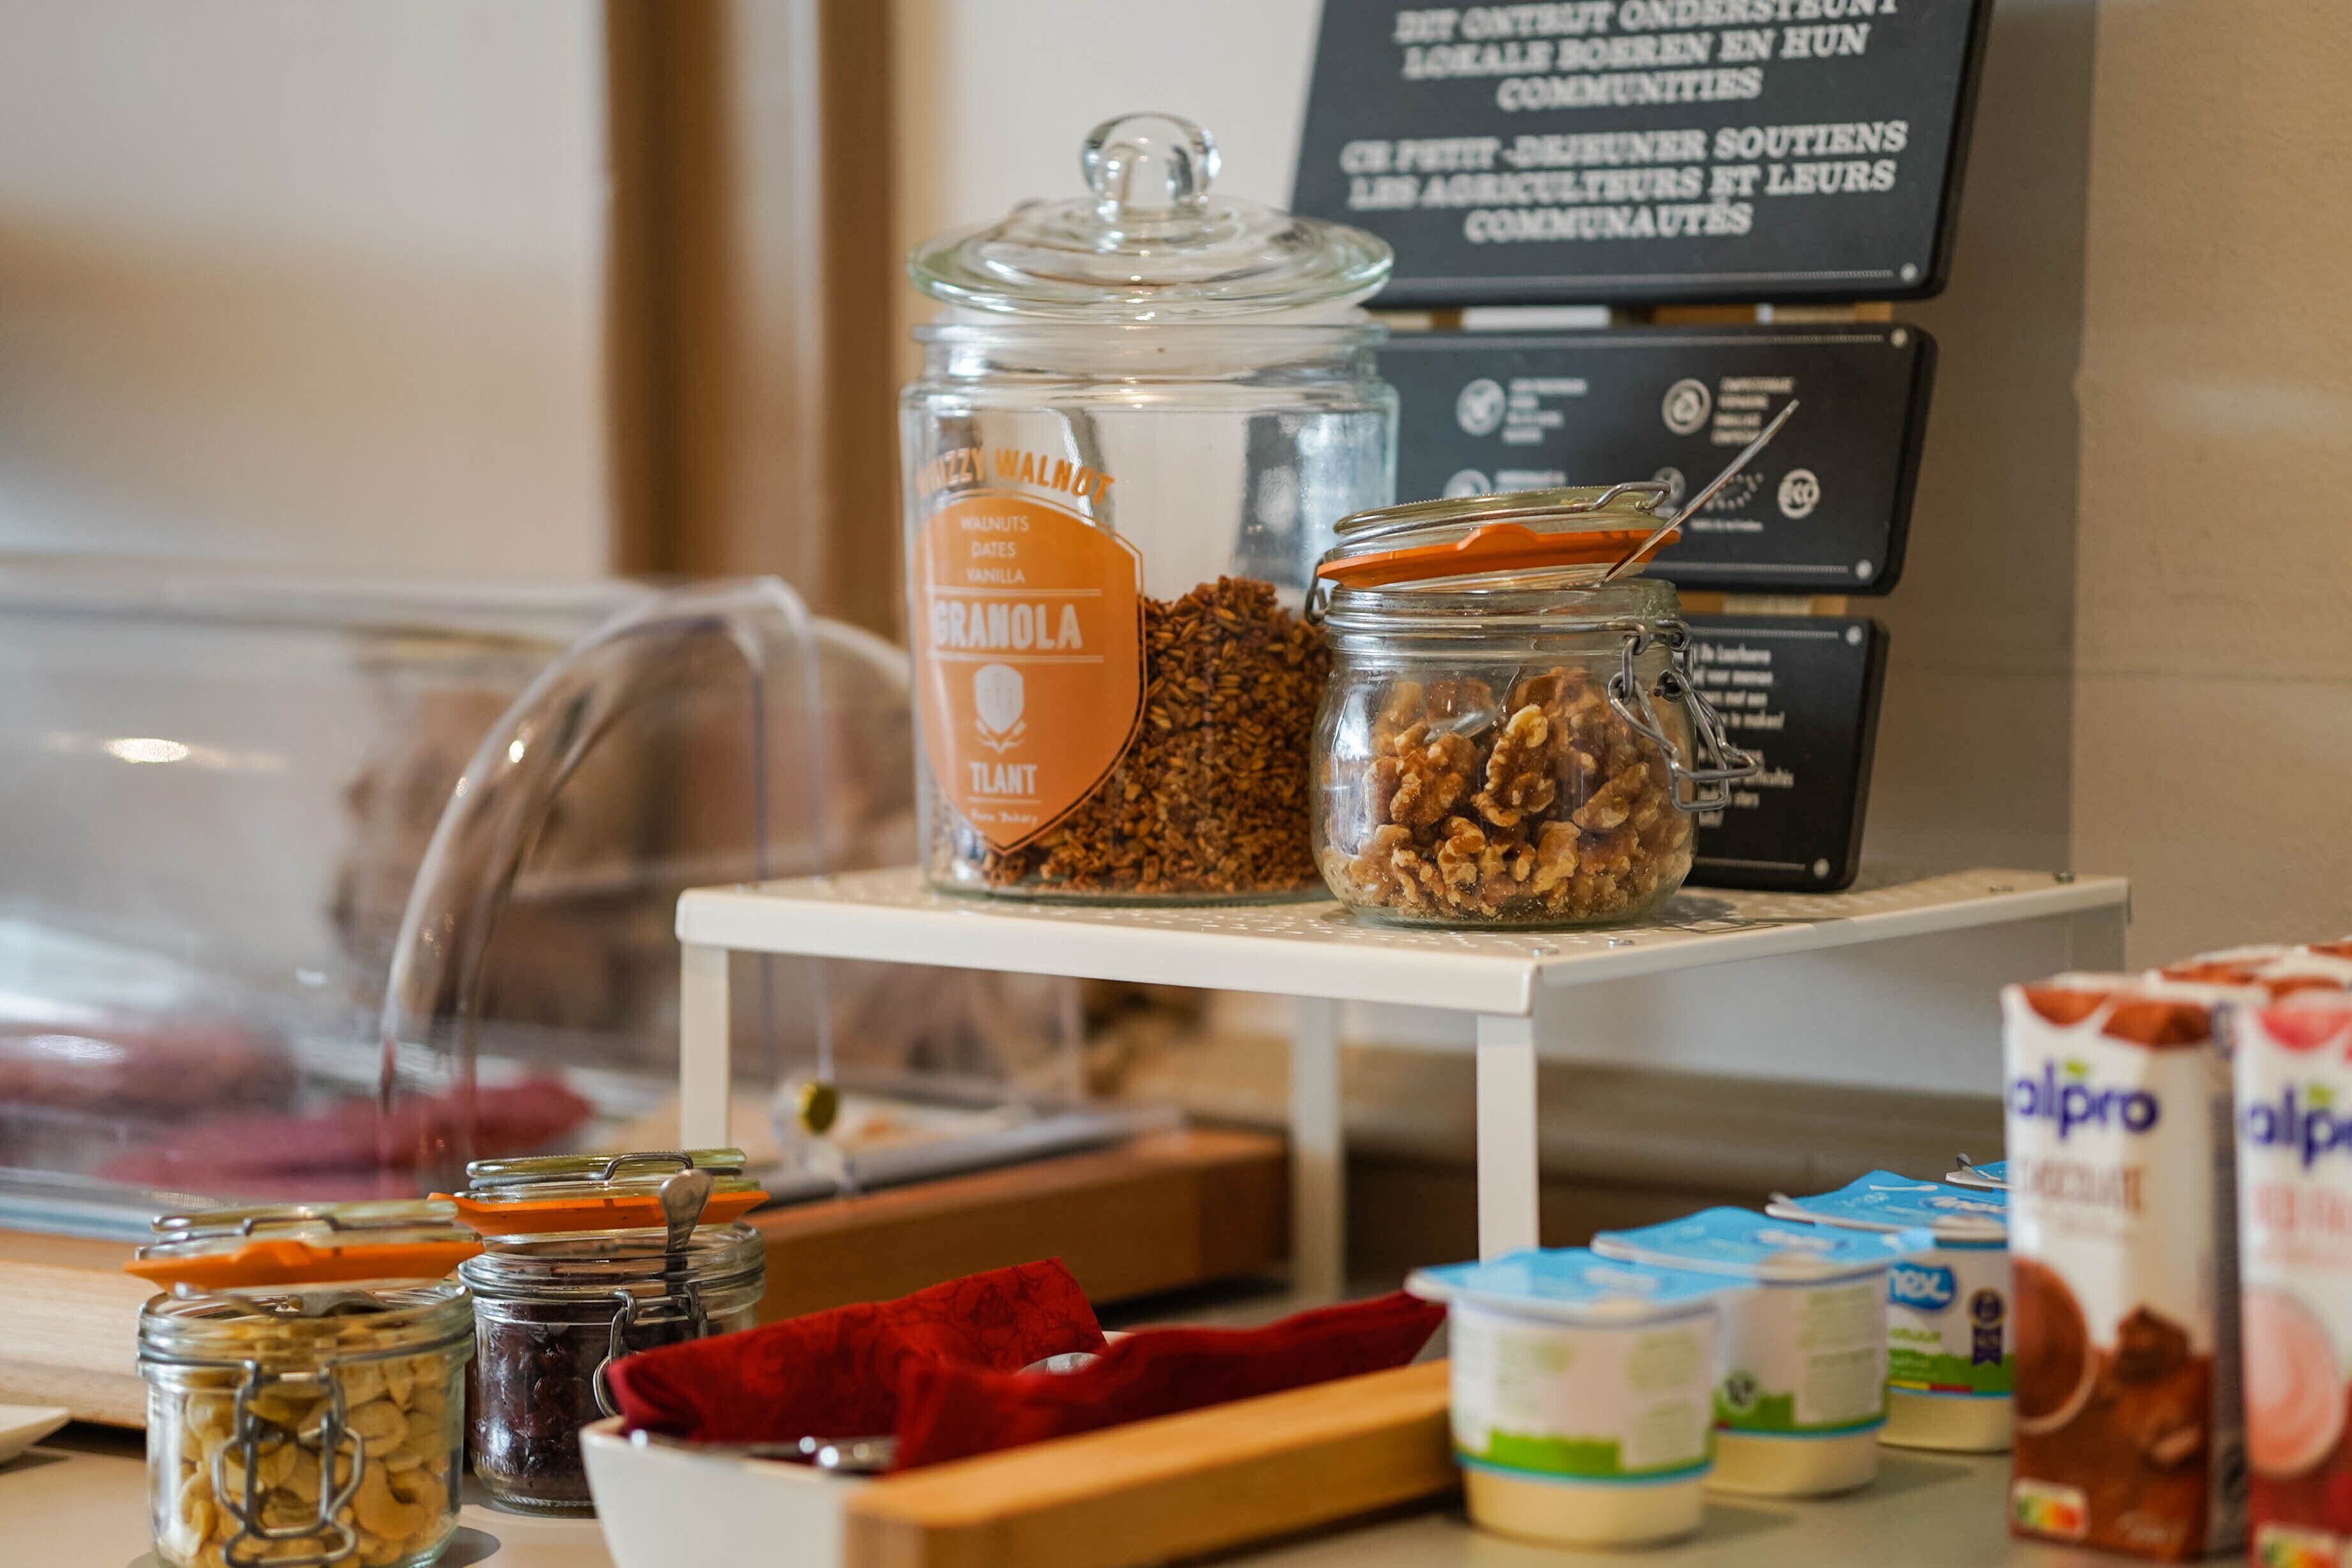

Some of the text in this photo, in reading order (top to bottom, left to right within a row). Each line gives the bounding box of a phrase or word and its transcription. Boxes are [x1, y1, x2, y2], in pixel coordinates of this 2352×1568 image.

[1402, 23, 1871, 80] LOKALE BOEREN EN HUN
[1497, 67, 1764, 112] COMMUNITIES
[1713, 121, 1909, 159] SOUTIENS
[1421, 166, 1703, 208] AGRICULTEURS
[1710, 165, 1761, 197] ET
[1765, 159, 1897, 195] LEURS
[995, 448, 1114, 505] WALNUT
[961, 516, 1030, 531] WALNUTS
[972, 542, 1016, 557] DATES
[966, 567, 1026, 583] VANILLA
[934, 600, 1083, 650] GRANOLA
[969, 762, 1038, 794] TLANT
[2013, 1063, 2161, 1140] alpro
[2239, 1086, 2352, 1170] alp
